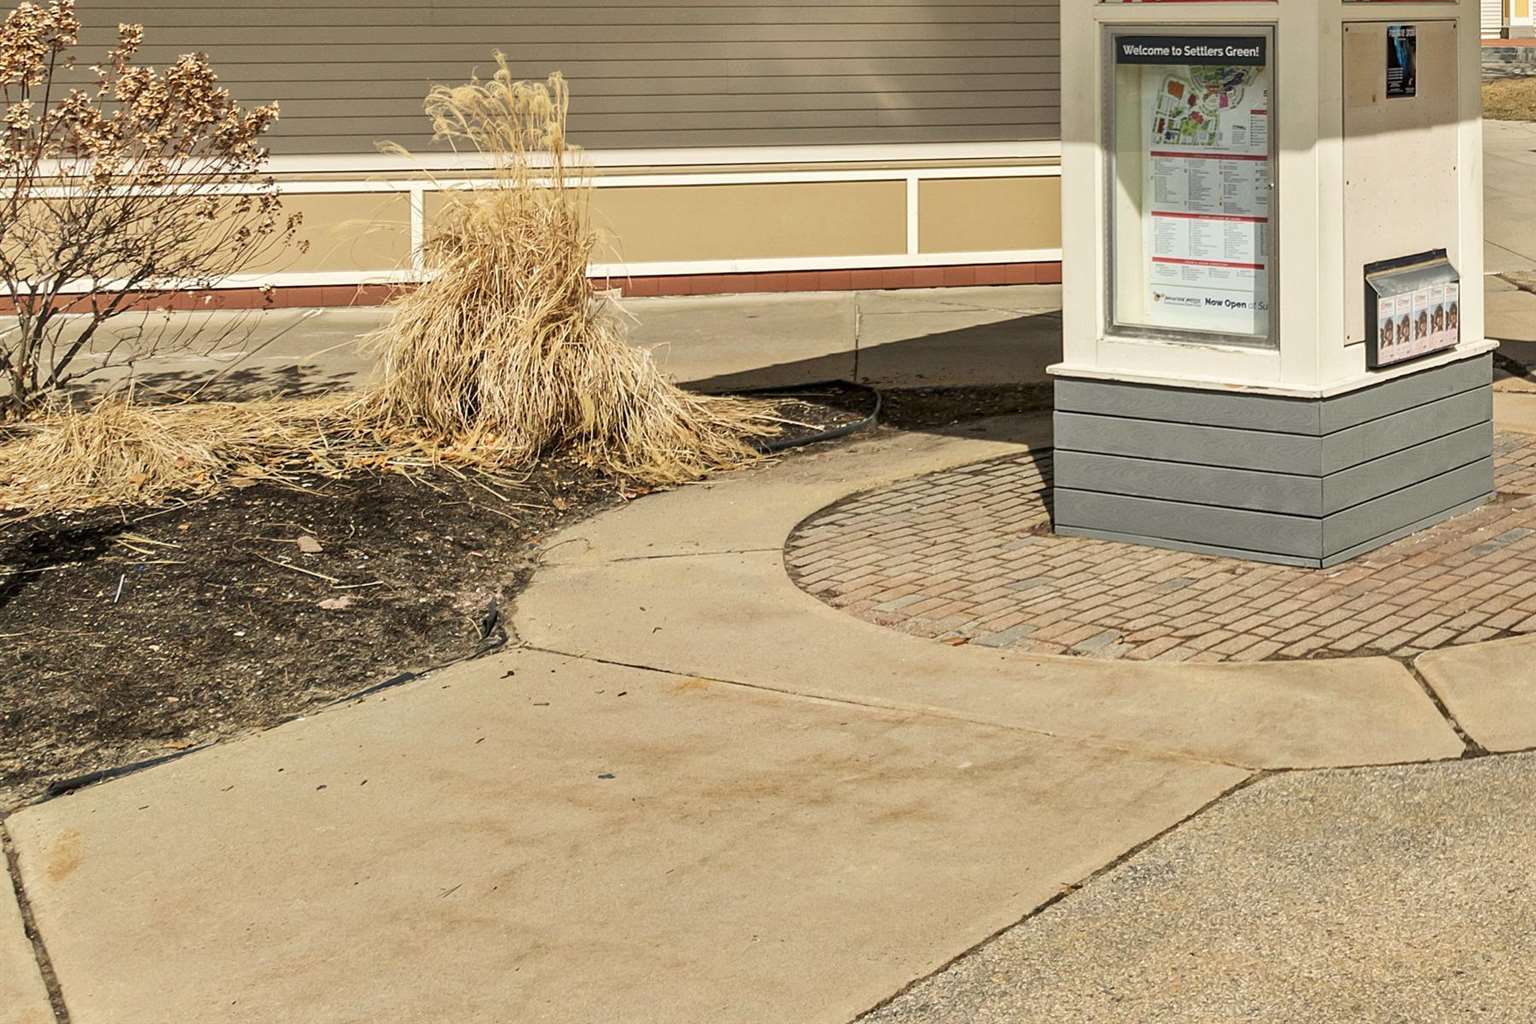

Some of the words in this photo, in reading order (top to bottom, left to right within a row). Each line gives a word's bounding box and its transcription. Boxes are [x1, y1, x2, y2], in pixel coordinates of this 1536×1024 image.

[1122, 45, 1170, 56] Welcome
[1171, 46, 1182, 56] to
[1183, 46, 1224, 57] Settlers
[1225, 46, 1260, 57] Green!
[1204, 297, 1224, 306] Now
[1224, 299, 1248, 310] Open
